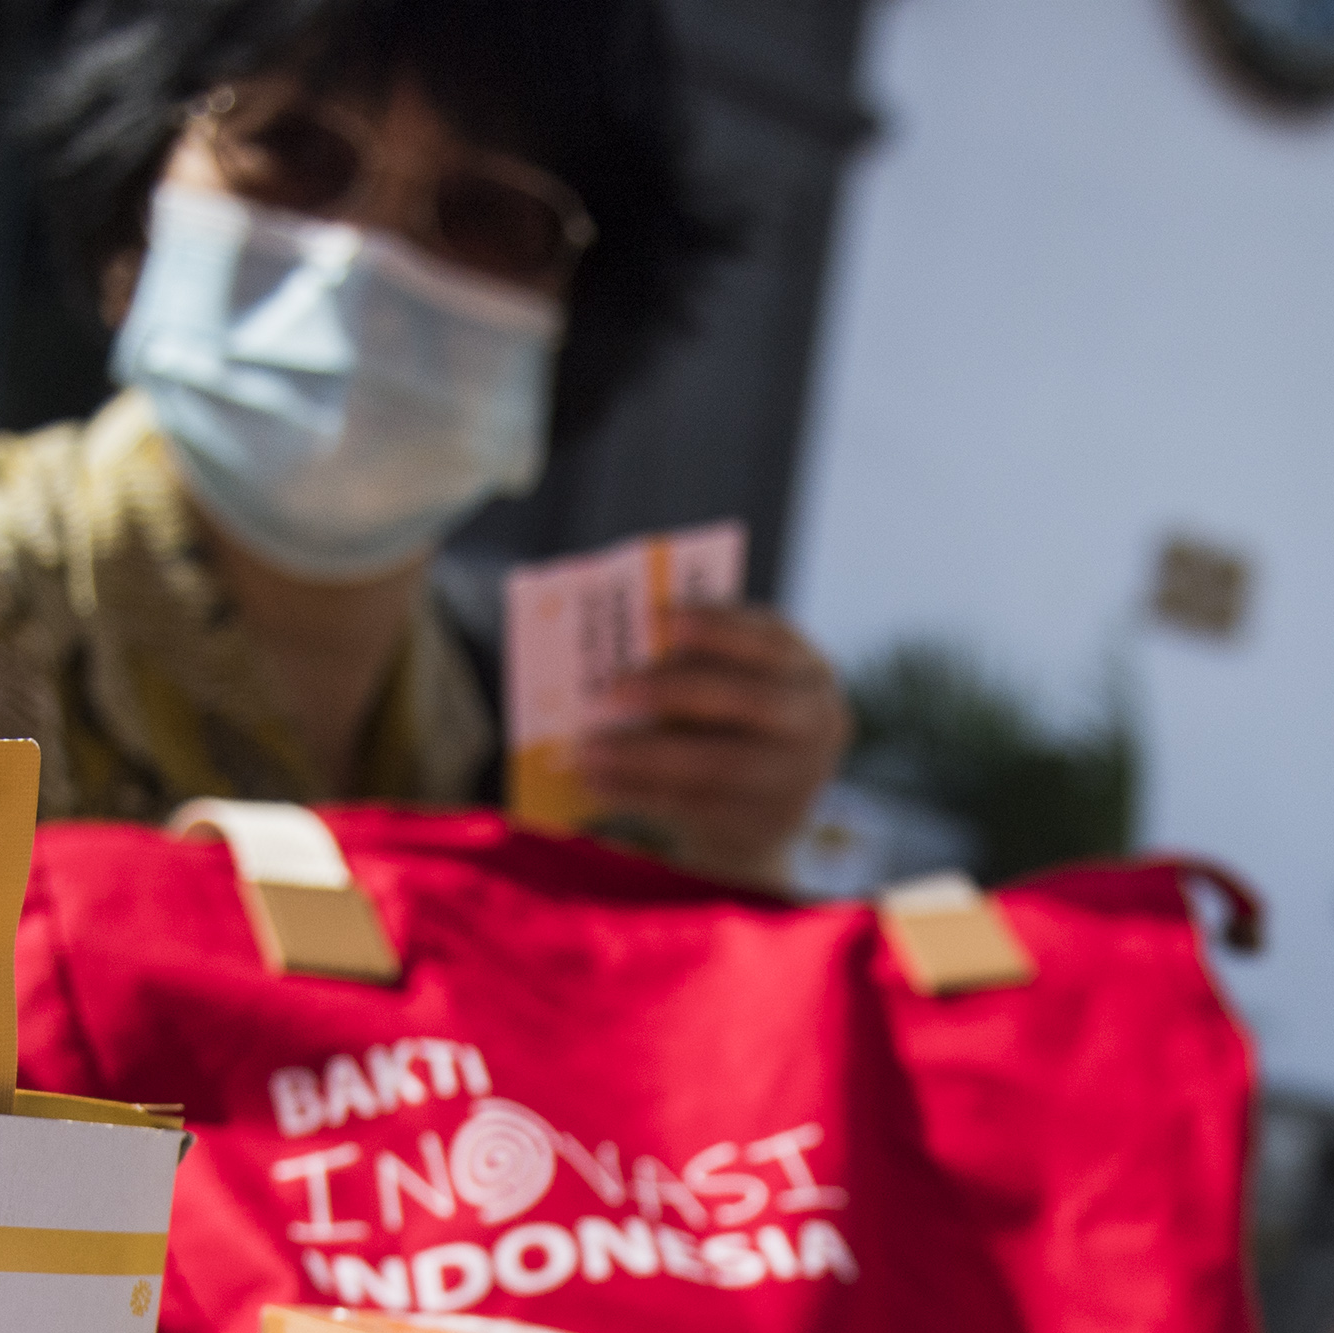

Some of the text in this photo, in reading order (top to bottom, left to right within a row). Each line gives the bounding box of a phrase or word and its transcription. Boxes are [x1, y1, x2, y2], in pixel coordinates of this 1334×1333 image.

[269, 1037, 491, 1138] BAKTI
[272, 1097, 849, 1243] INOVASI
[304, 1215, 860, 1313] INDONESIA
